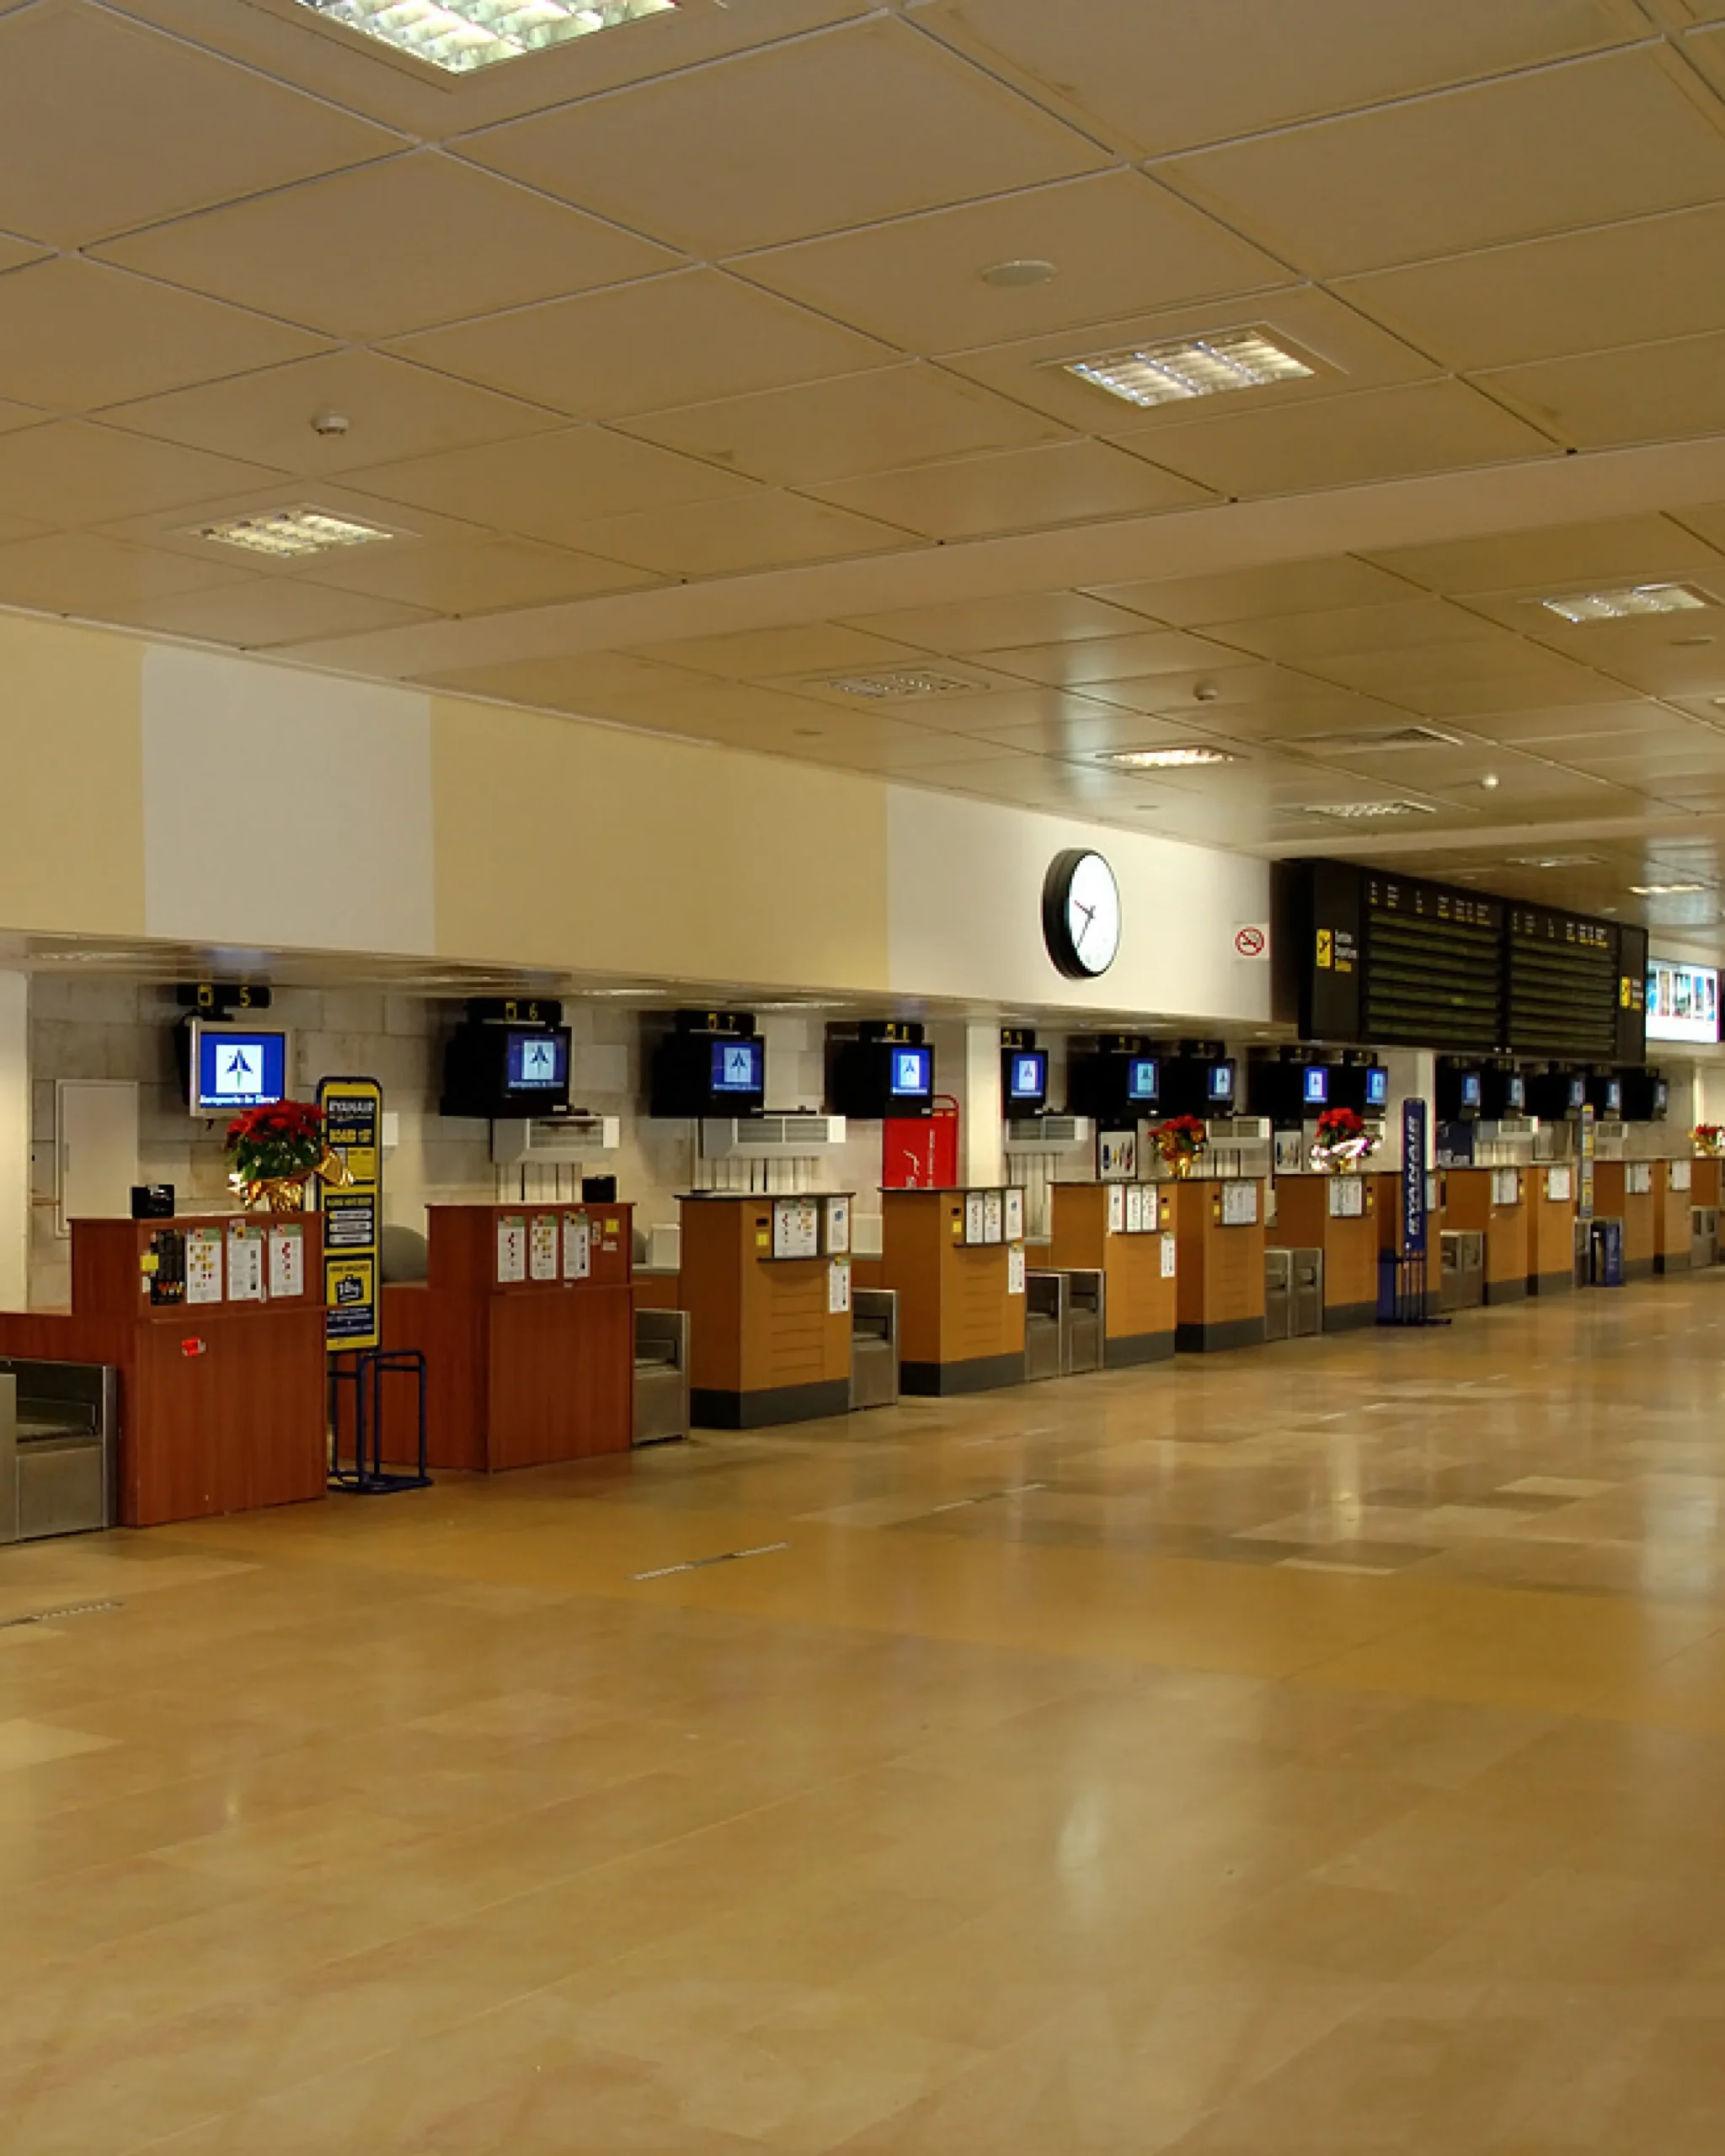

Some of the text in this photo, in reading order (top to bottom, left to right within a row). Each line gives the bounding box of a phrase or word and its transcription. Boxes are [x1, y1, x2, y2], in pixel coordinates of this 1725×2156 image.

[240, 987, 250, 1007] 5
[530, 1003, 538, 1021] 6
[1407, 1116, 1422, 1235] RYANAIR
